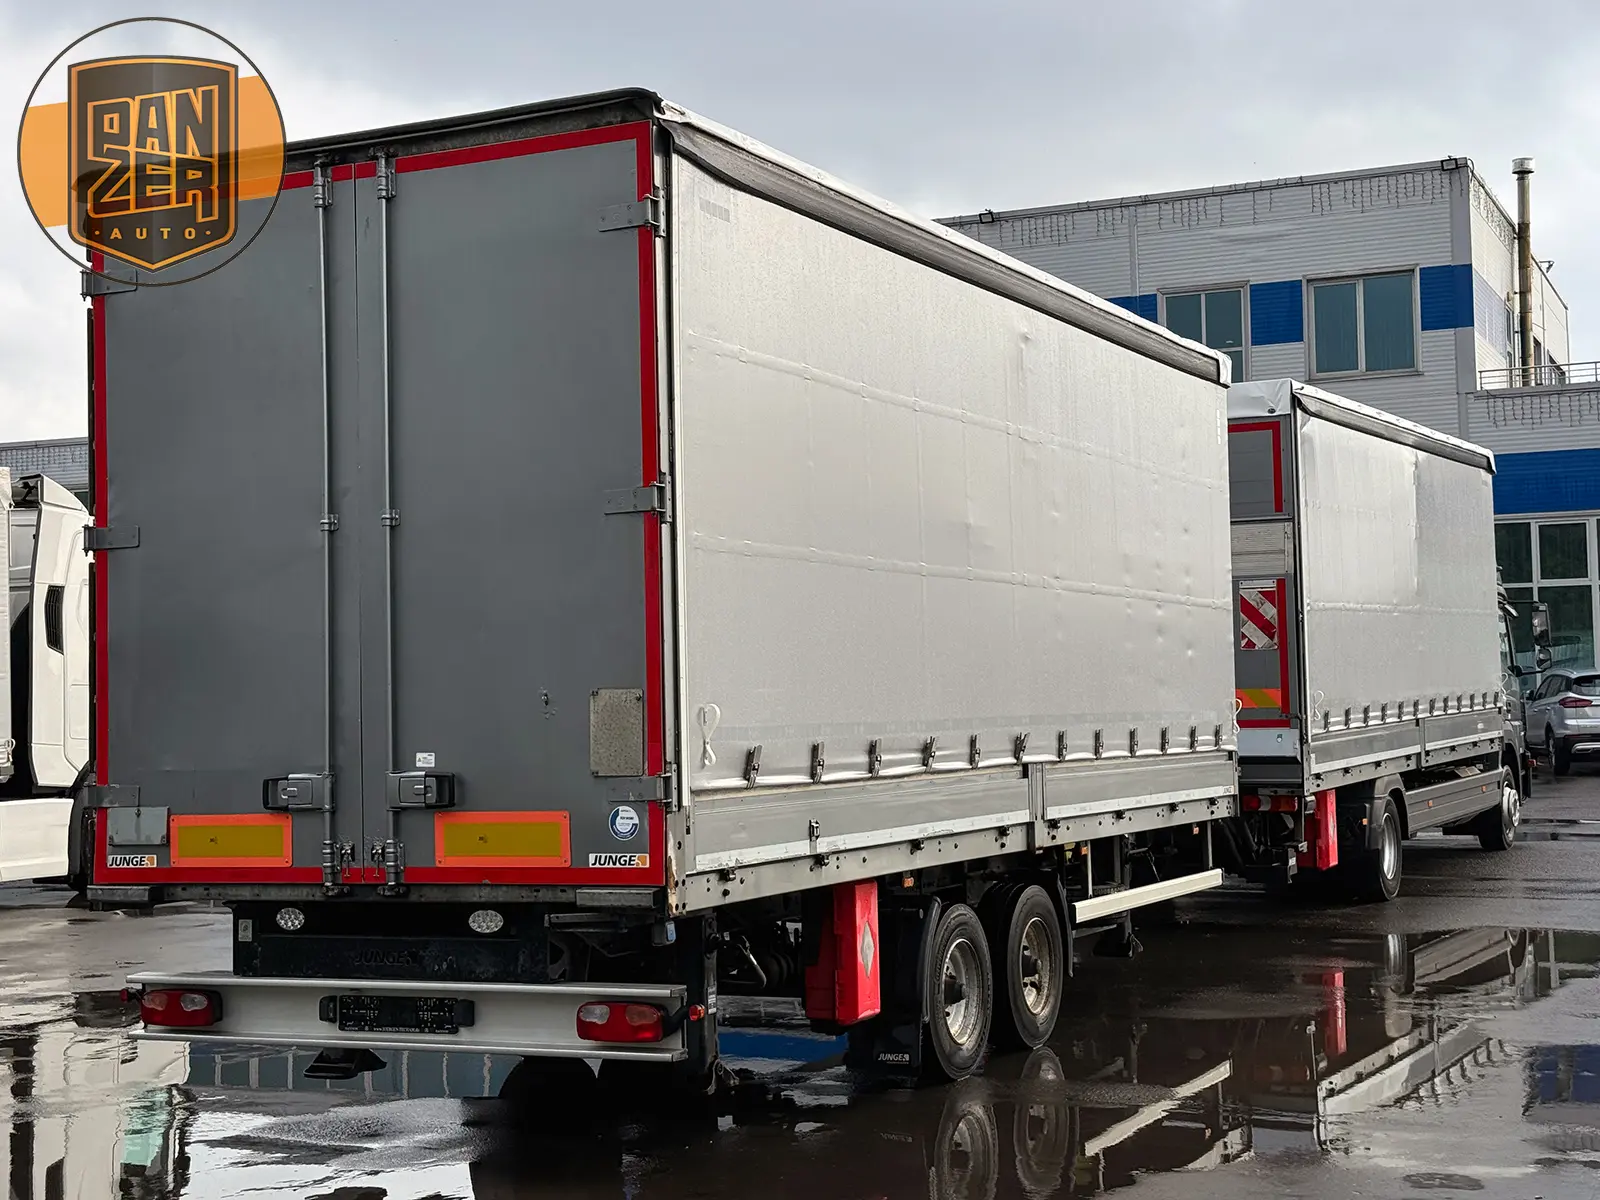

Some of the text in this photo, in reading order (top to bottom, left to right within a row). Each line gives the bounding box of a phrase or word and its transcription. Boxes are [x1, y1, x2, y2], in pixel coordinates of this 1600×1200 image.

[109, 856, 146, 866] JUNGE
[592, 855, 637, 866] JUNGE
[877, 1053, 904, 1061] JUNGE
